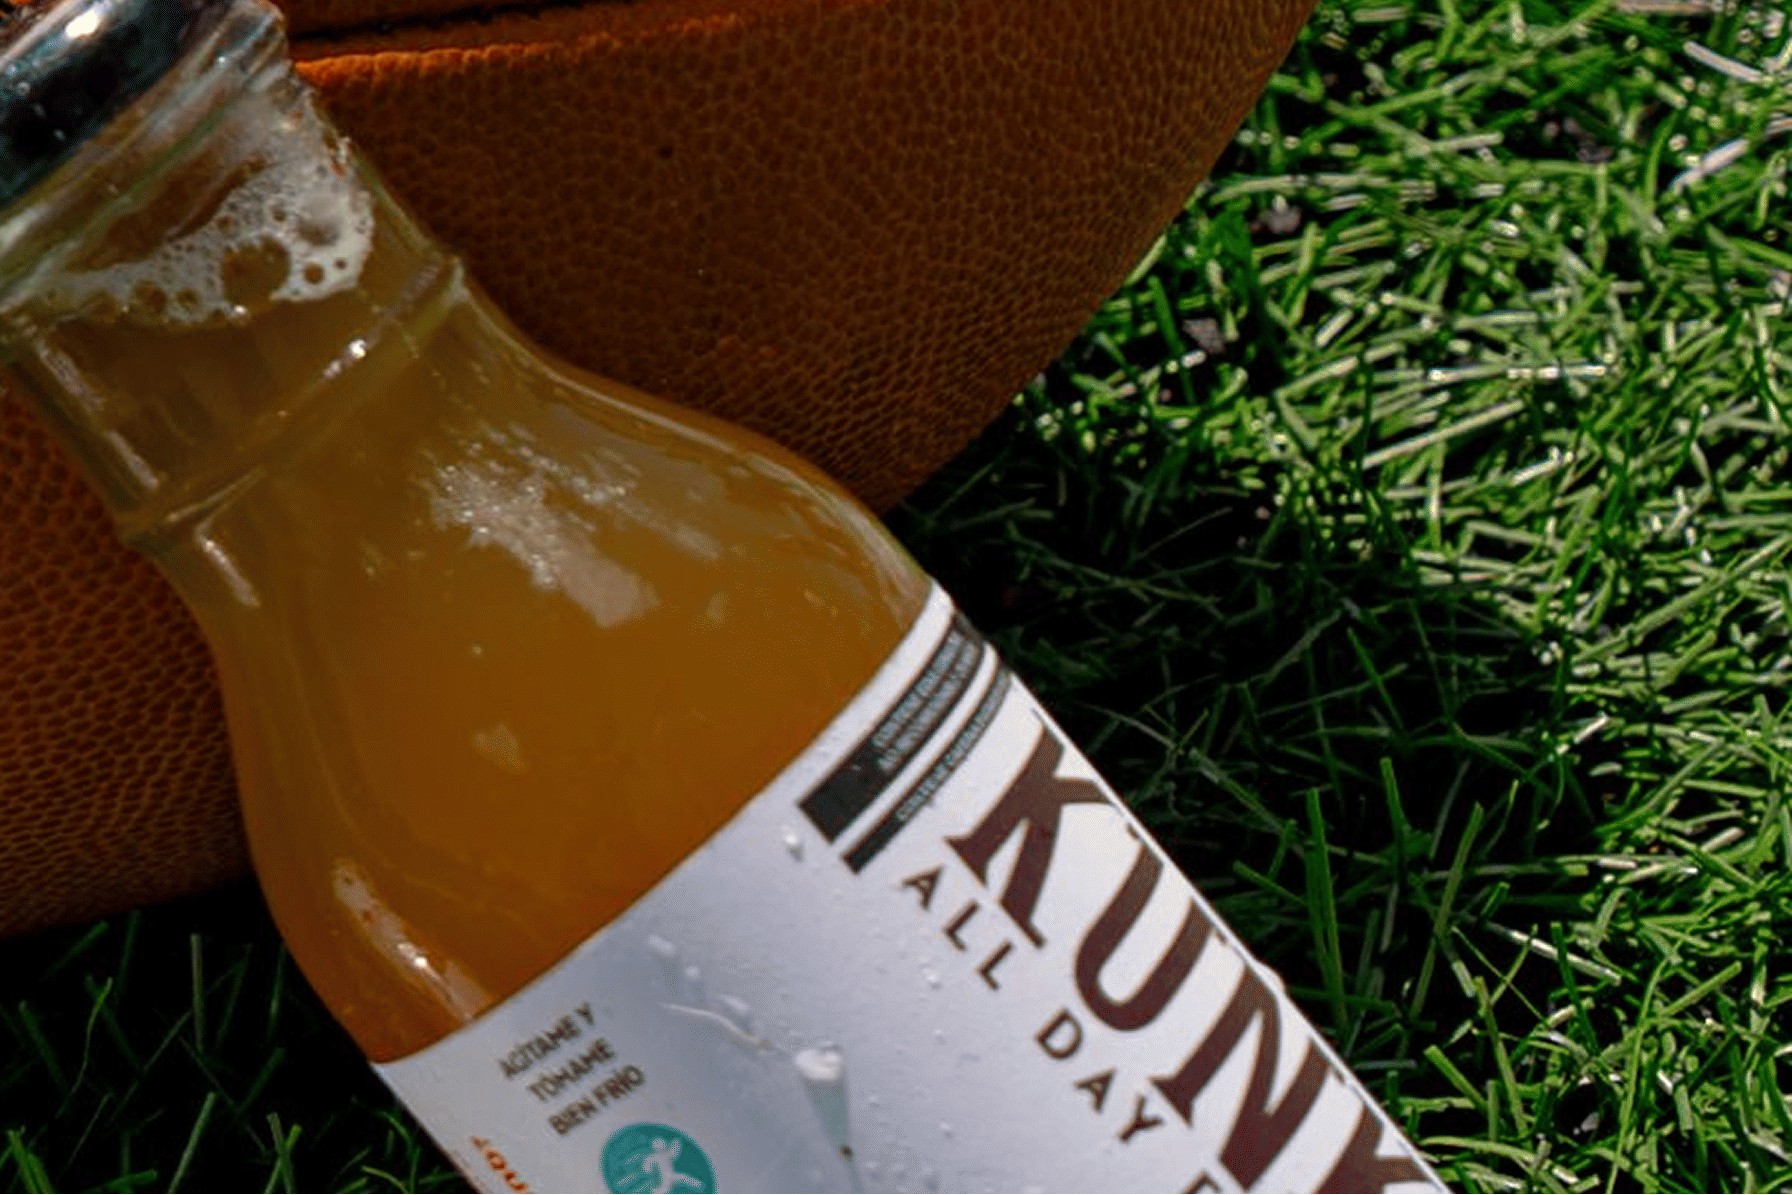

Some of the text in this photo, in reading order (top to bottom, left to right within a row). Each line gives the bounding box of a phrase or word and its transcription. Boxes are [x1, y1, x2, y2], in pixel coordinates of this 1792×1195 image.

[572, 1000, 597, 1028] Y
[901, 866, 1014, 991] ALL
[1034, 1008, 1164, 1144] DAY
[547, 1095, 601, 1137] BIEN
